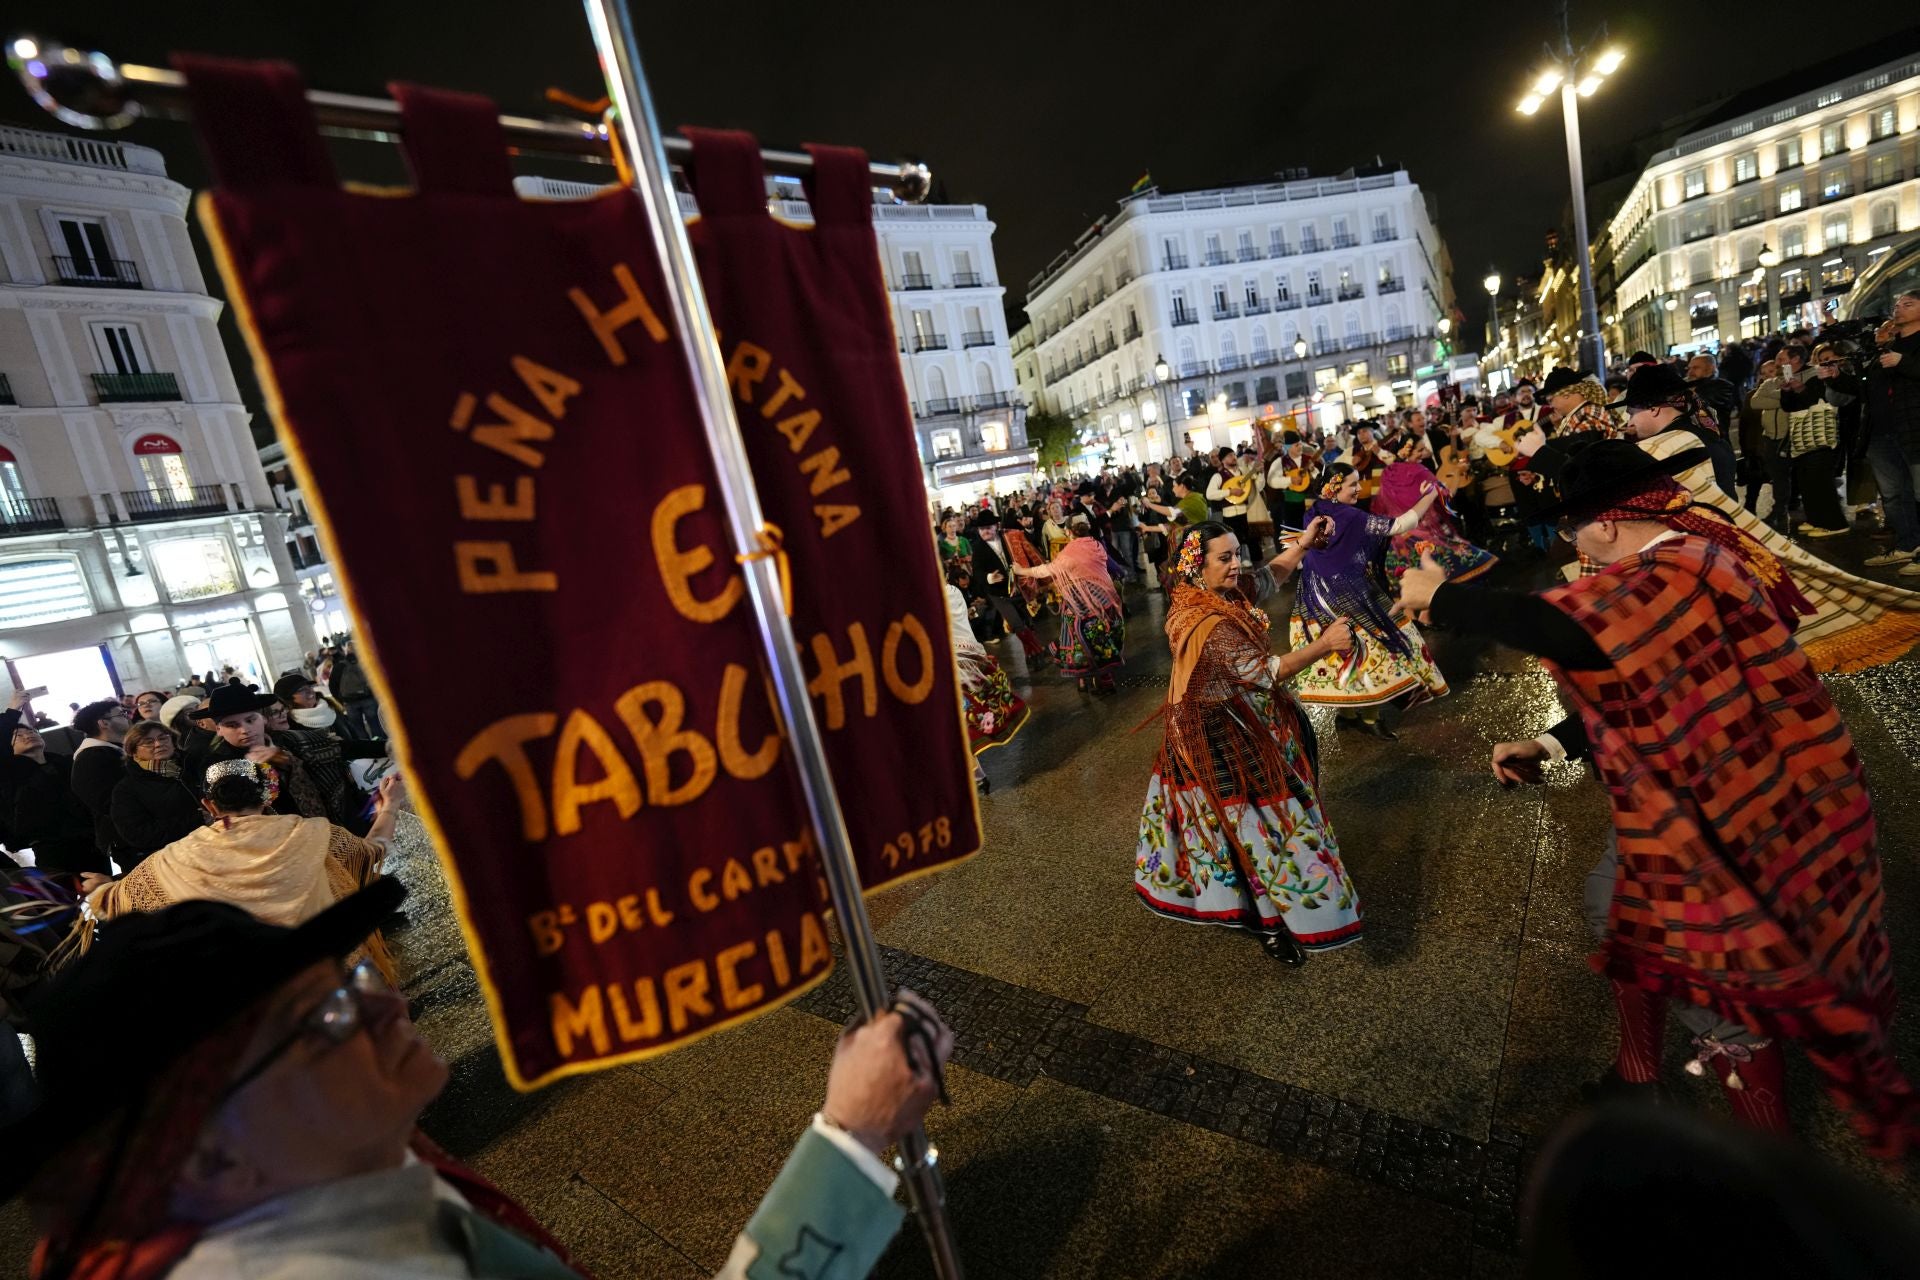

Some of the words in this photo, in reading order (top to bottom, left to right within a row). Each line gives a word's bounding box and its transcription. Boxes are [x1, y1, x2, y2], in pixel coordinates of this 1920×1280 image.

[449, 354, 582, 593] PEÑA
[568, 263, 862, 539] HRTANA
[584, 885, 696, 944] DEL
[687, 826, 820, 913] CARM
[879, 815, 953, 871] 1978
[549, 909, 831, 1059] MURCIA
